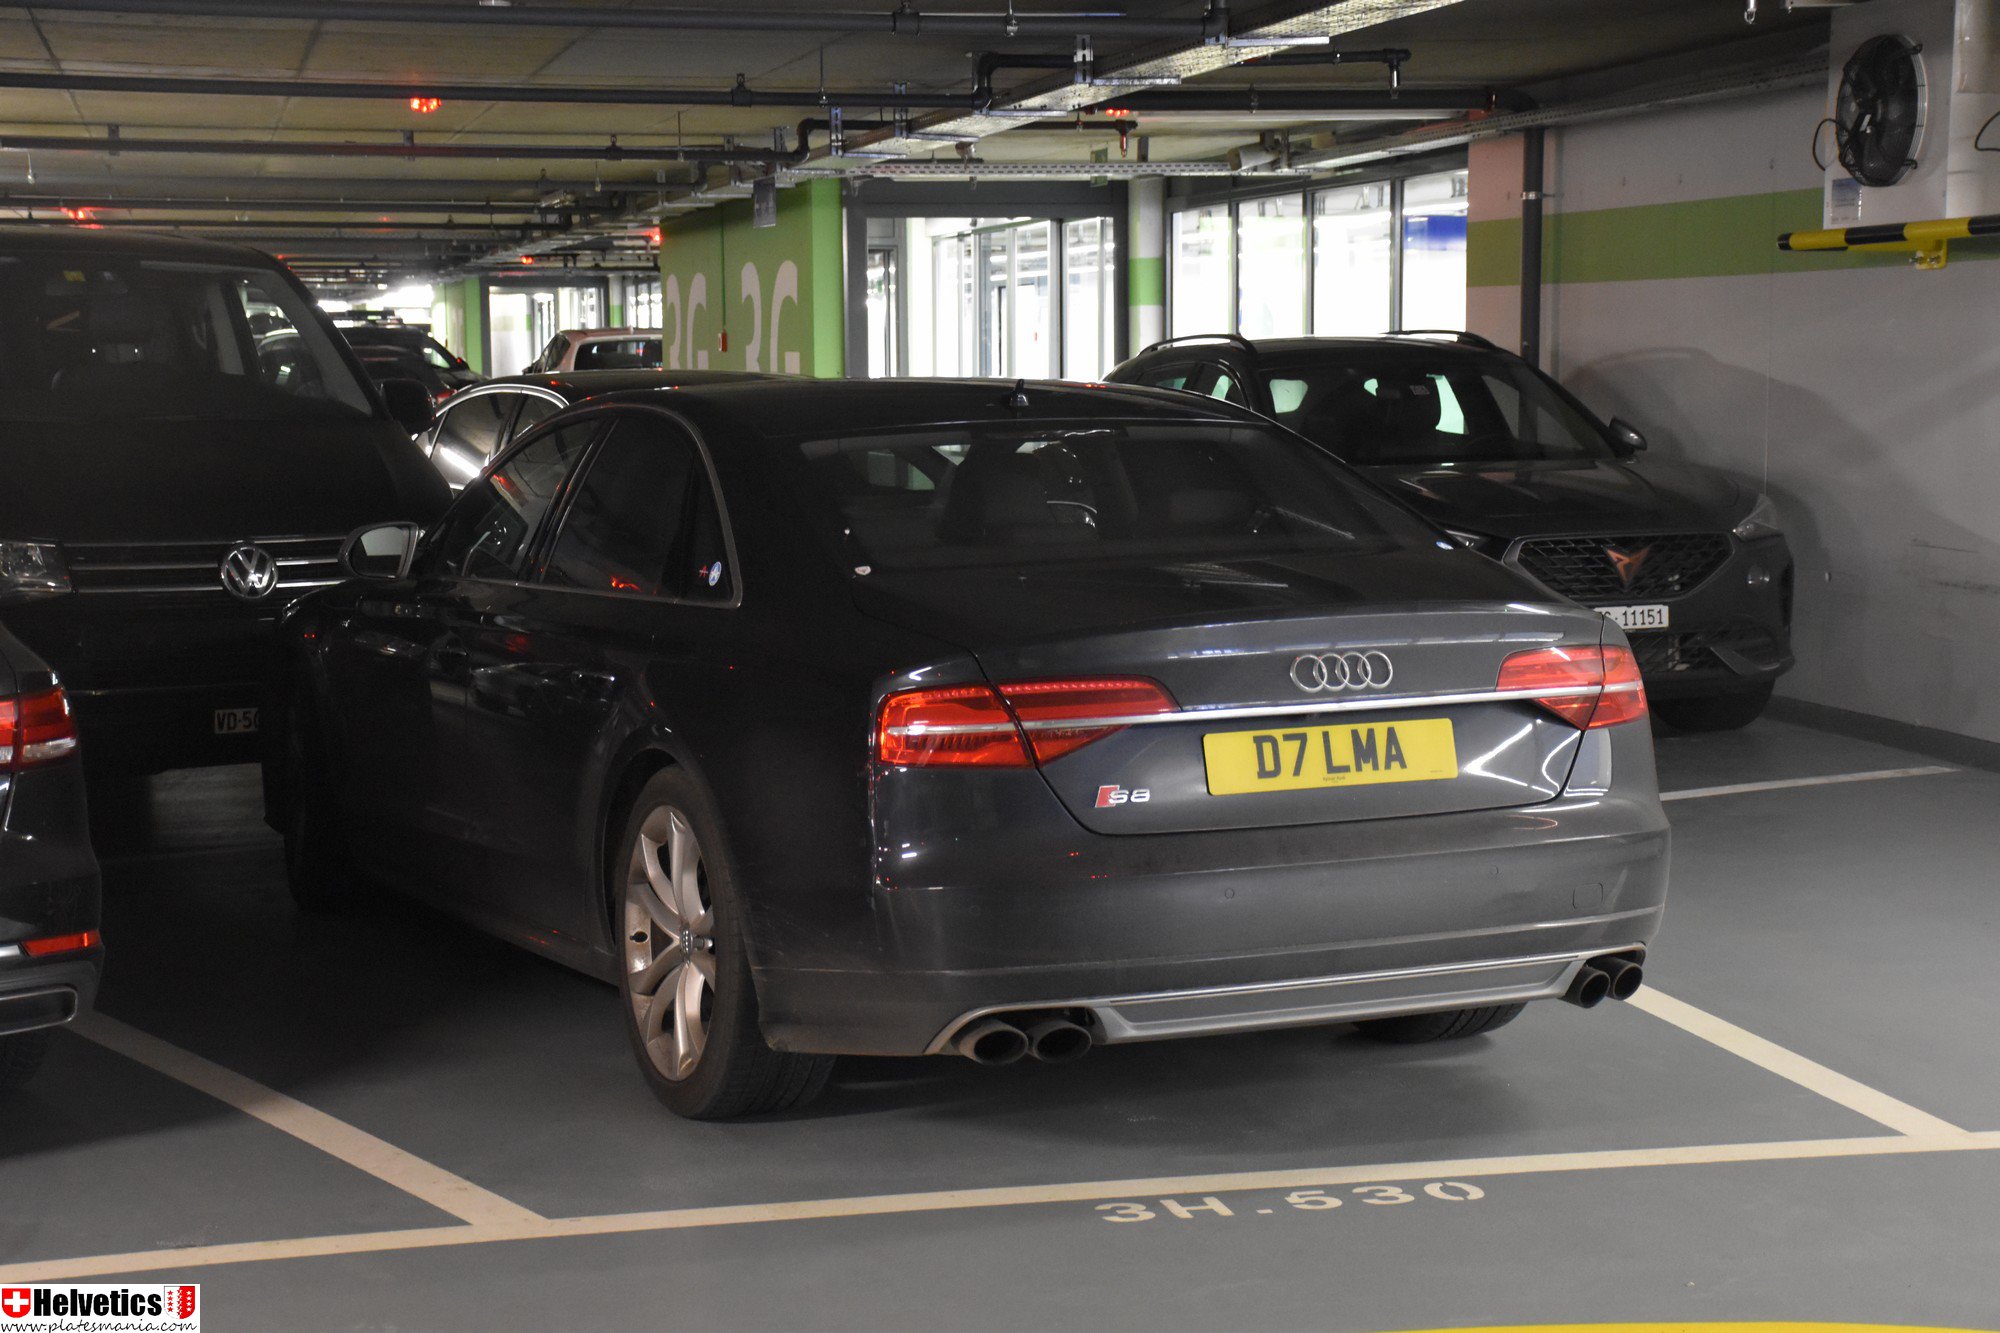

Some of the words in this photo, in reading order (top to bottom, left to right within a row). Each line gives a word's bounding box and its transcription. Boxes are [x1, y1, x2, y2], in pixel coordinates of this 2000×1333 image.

[1252, 732, 1308, 780] D7
[1322, 726, 1408, 775] LMA
[1108, 788, 1151, 804] S8
